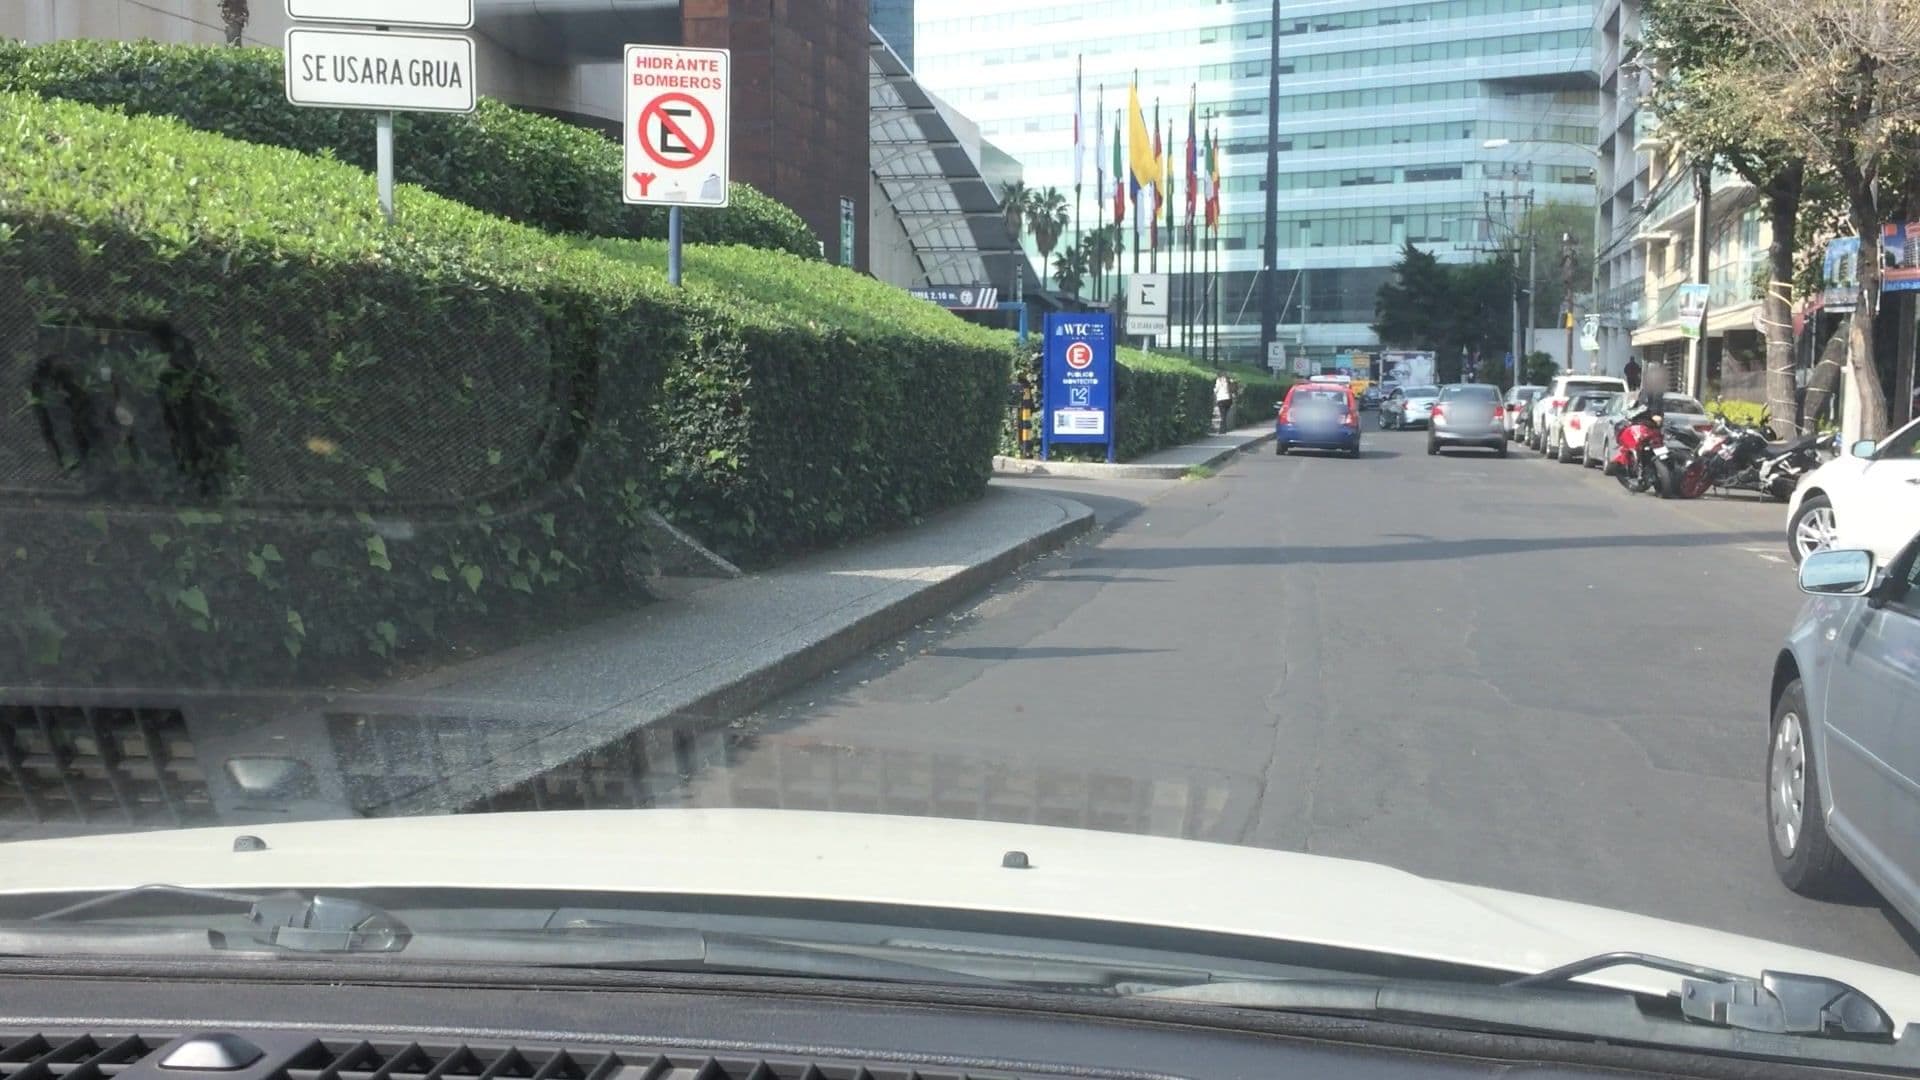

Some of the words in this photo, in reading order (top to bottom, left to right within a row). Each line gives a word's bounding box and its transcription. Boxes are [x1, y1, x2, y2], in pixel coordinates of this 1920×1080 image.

[302, 54, 327, 82] SE
[333, 55, 404, 85] USARA
[408, 59, 463, 88] GRUA
[636, 56, 719, 72] HIDRANTE
[633, 73, 722, 90] BOMBEROS
[1063, 323, 1091, 336] WTC
[1072, 347, 1087, 364] E
